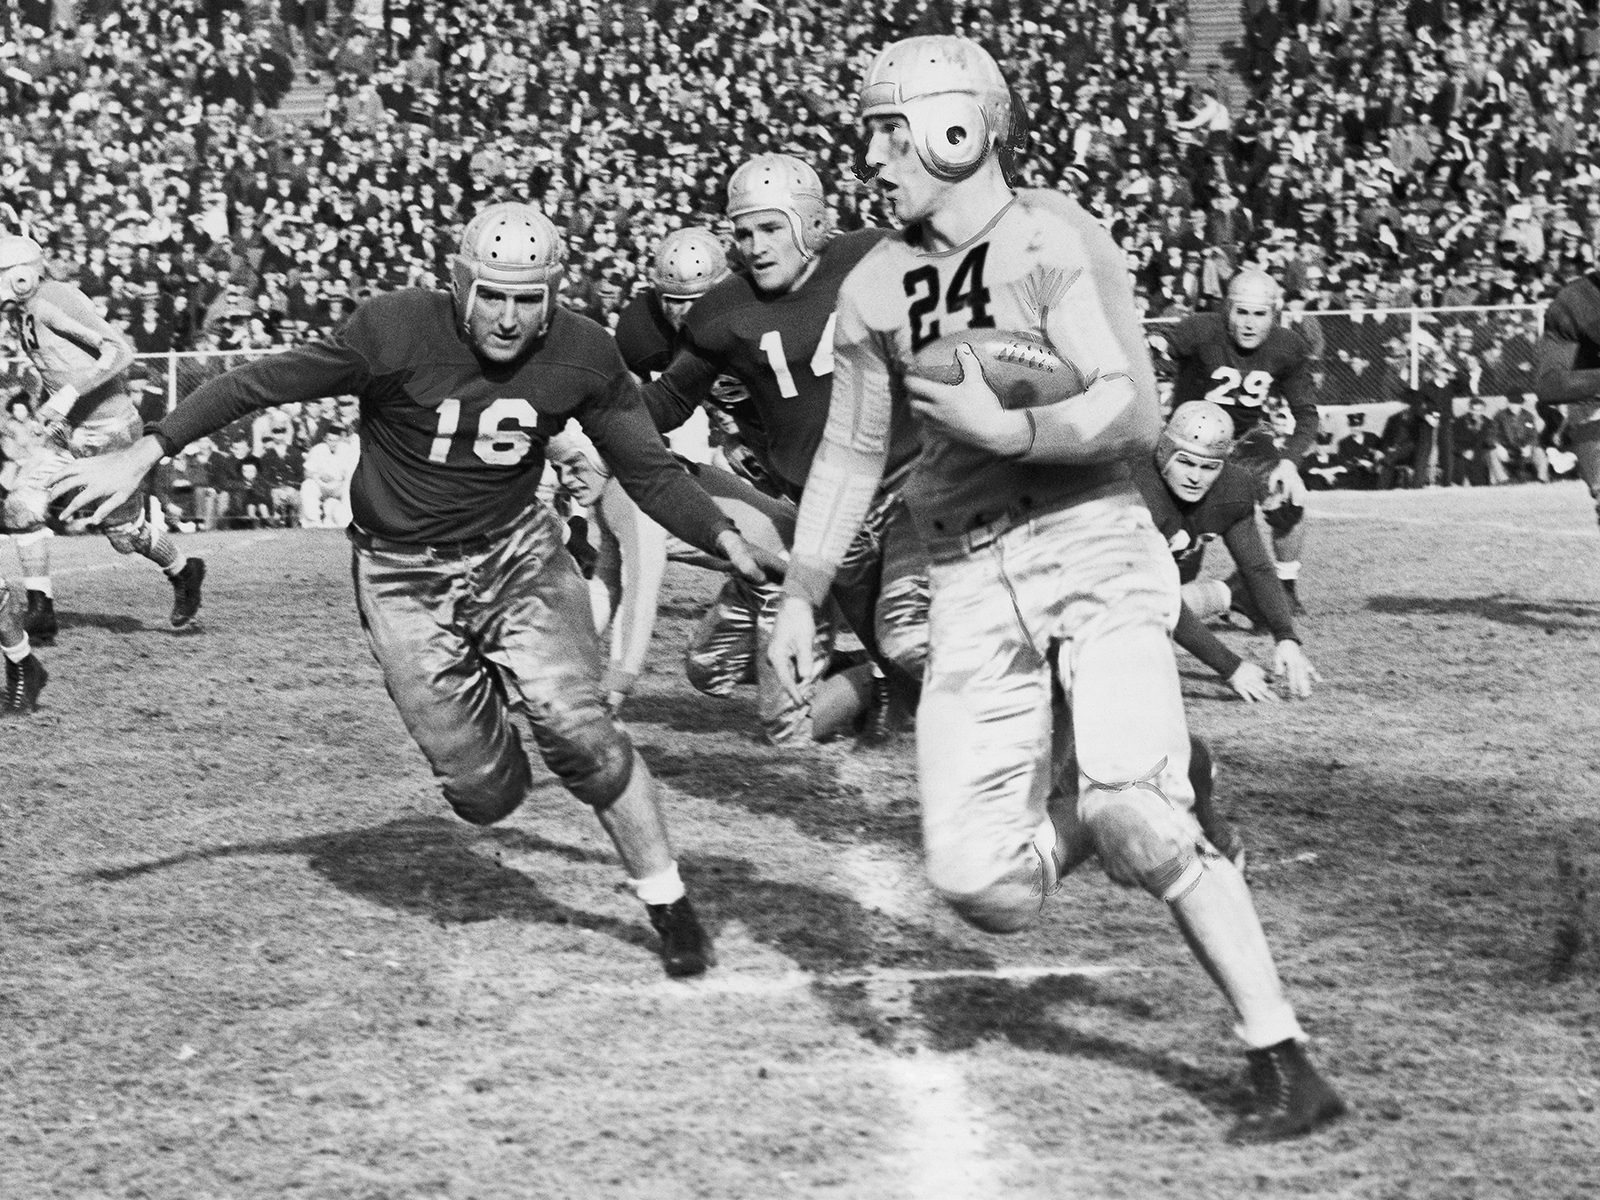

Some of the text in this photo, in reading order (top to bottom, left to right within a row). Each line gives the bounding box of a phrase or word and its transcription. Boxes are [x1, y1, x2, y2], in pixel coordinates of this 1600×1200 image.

[903, 241, 995, 354] 24
[1204, 365, 1274, 407] 29
[428, 398, 539, 466] 16
